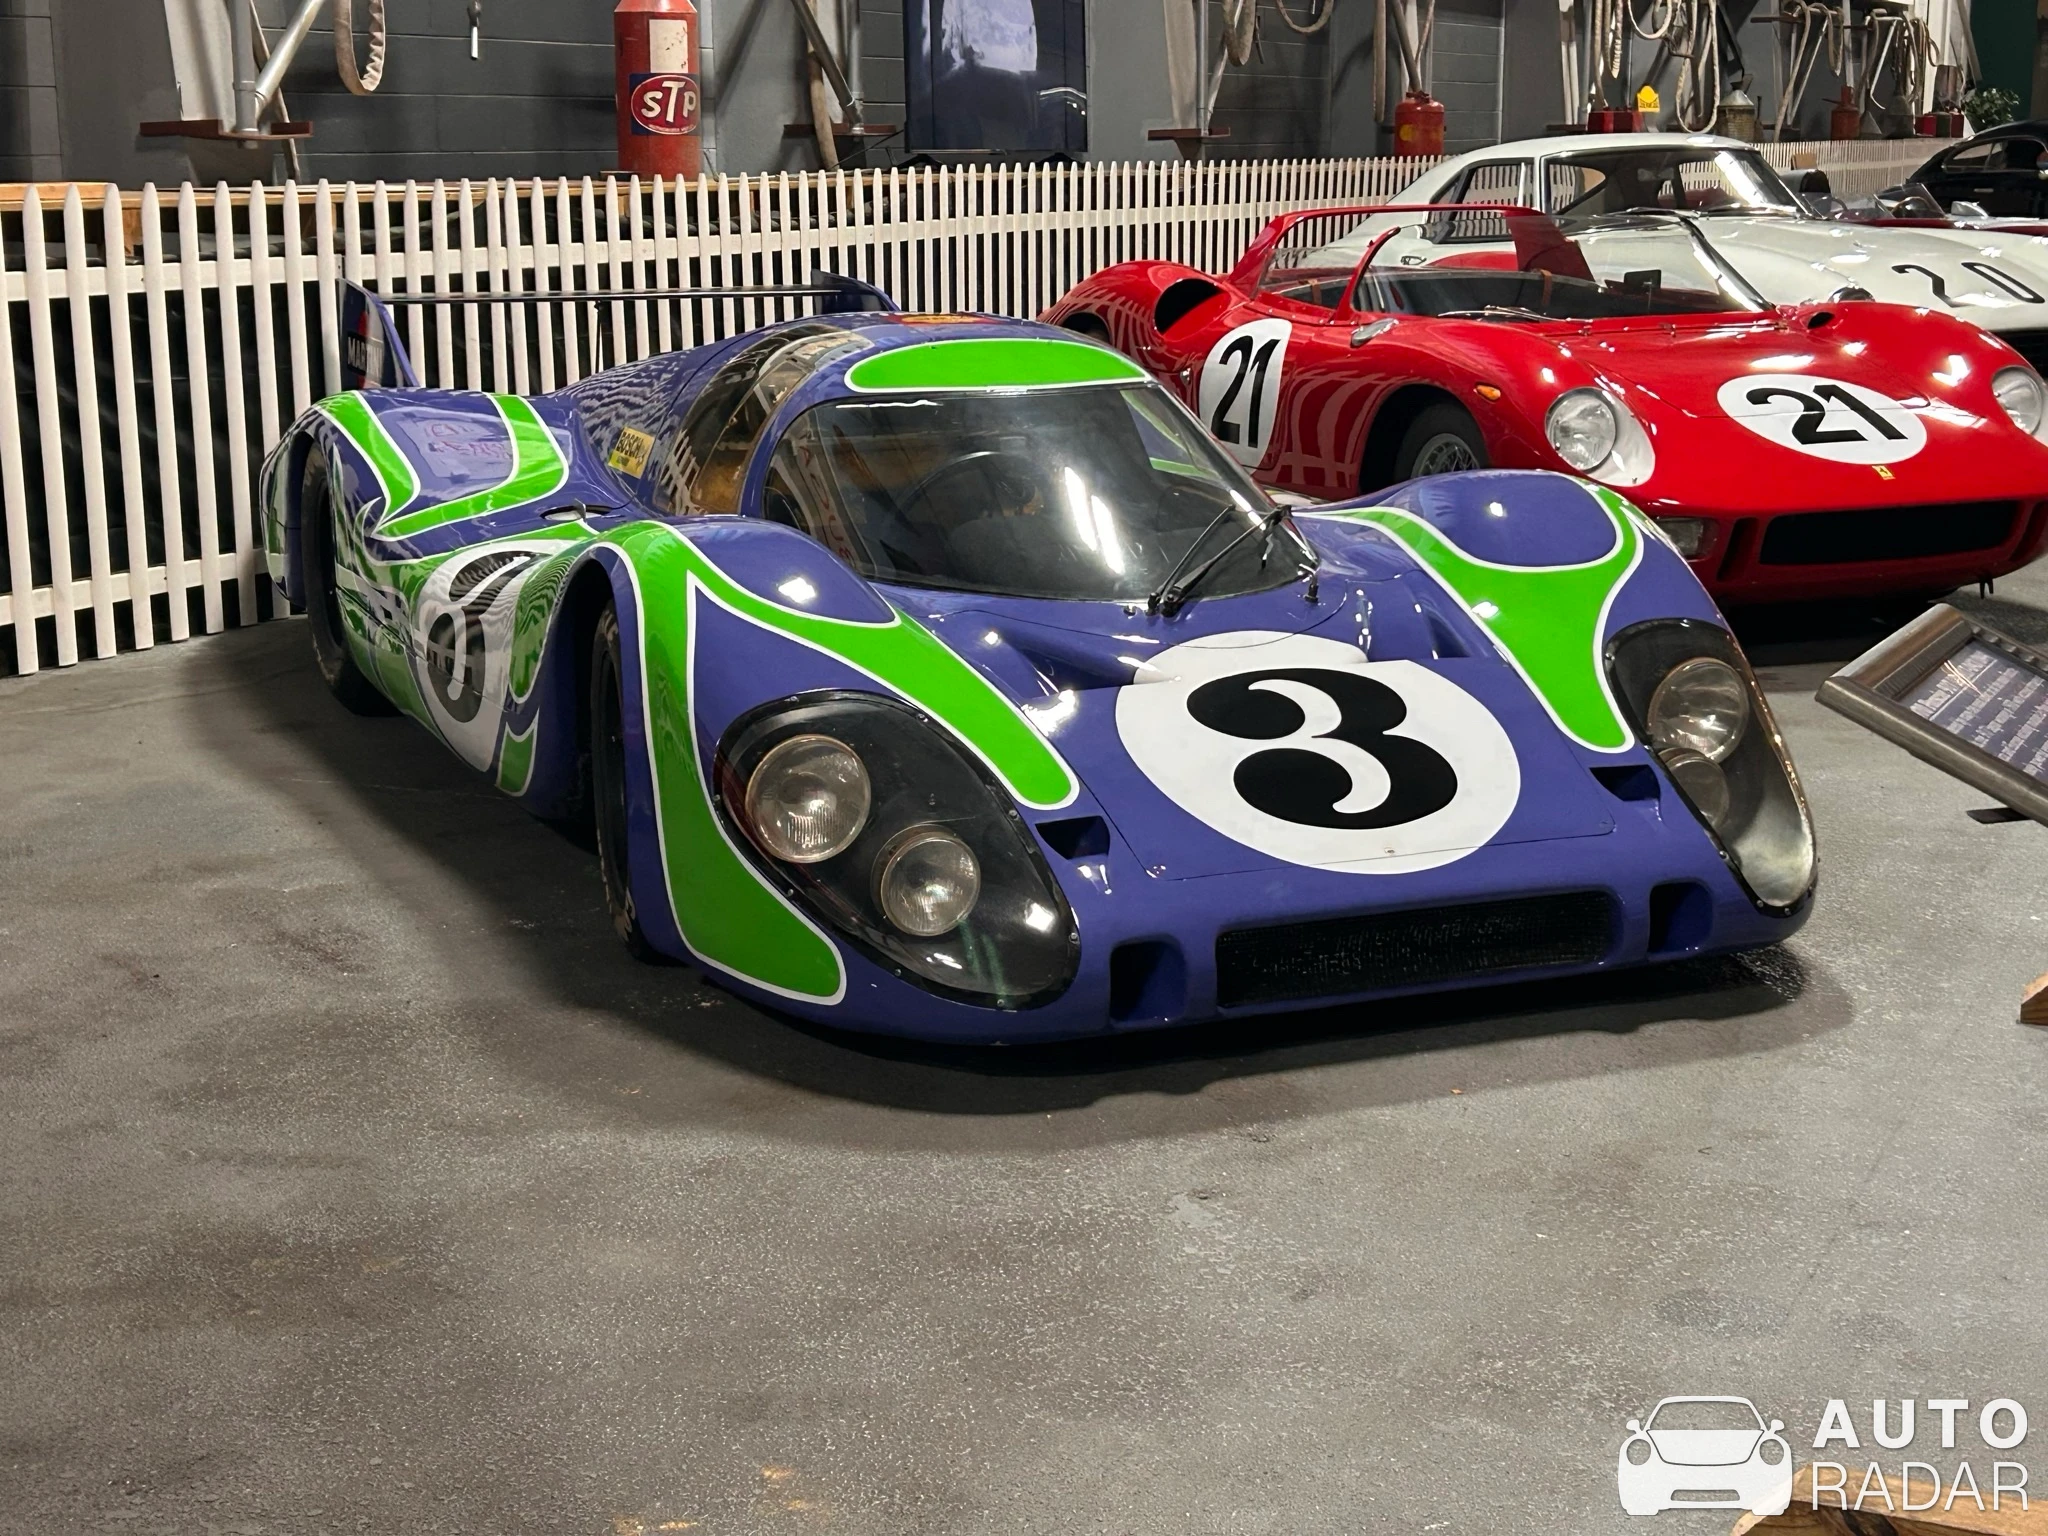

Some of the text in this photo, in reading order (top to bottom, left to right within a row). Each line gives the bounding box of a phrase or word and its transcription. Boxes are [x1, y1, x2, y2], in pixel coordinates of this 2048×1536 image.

[641, 81, 697, 123] STP
[1891, 262, 2045, 308] 20
[1211, 335, 1281, 448] 21
[1746, 385, 1908, 445] 21
[427, 550, 552, 723] 3
[1187, 667, 1459, 830] 3
